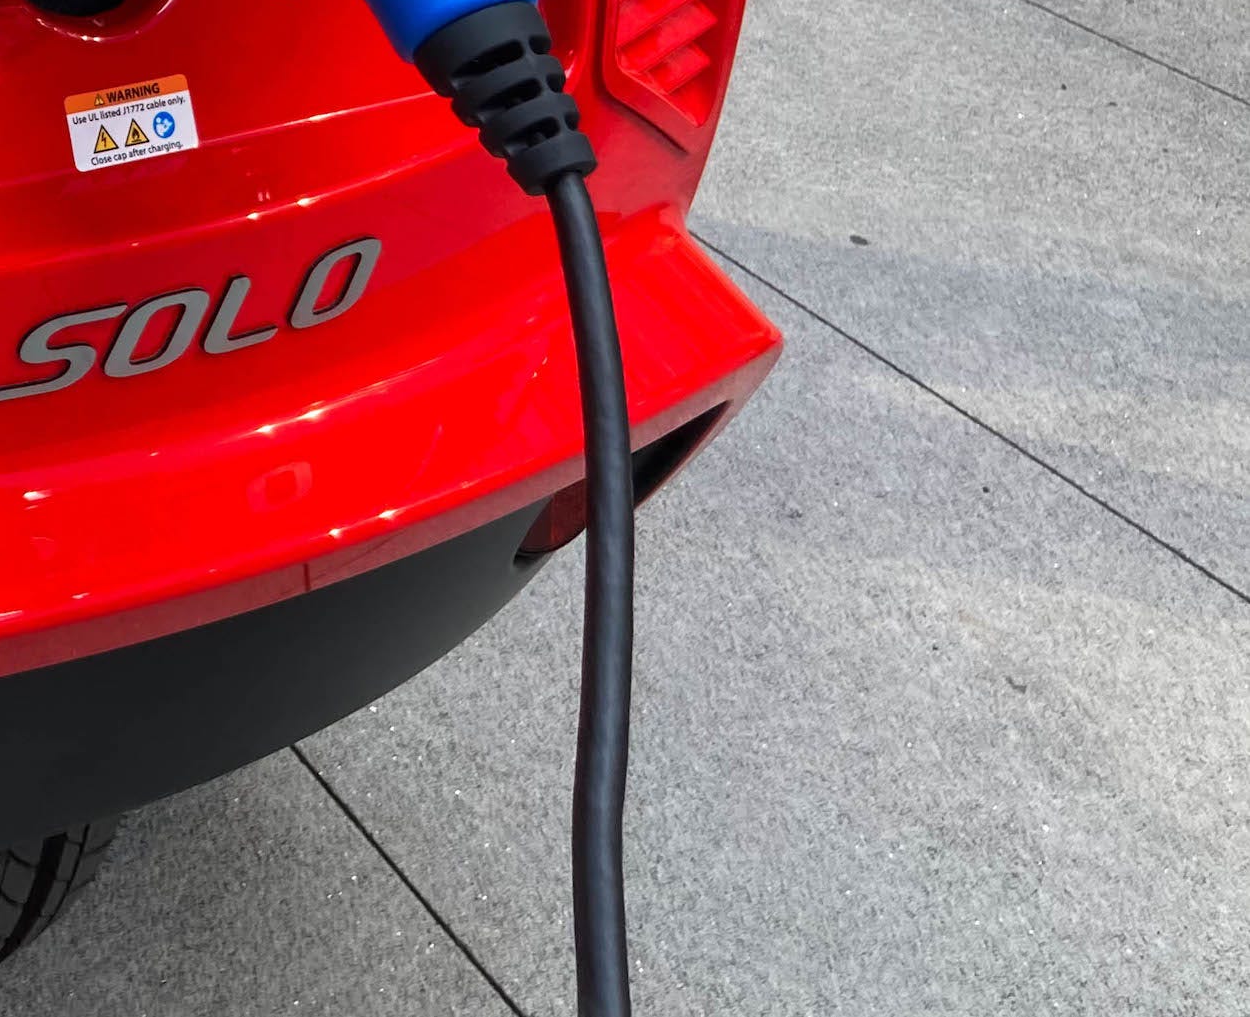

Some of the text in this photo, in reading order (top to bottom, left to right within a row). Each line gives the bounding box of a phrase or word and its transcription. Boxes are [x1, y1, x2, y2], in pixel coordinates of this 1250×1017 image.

[106, 83, 160, 103] WARNING
[72, 94, 186, 125] Use UL listed J1772 cable only.
[91, 140, 184, 166] Close cap after charging.
